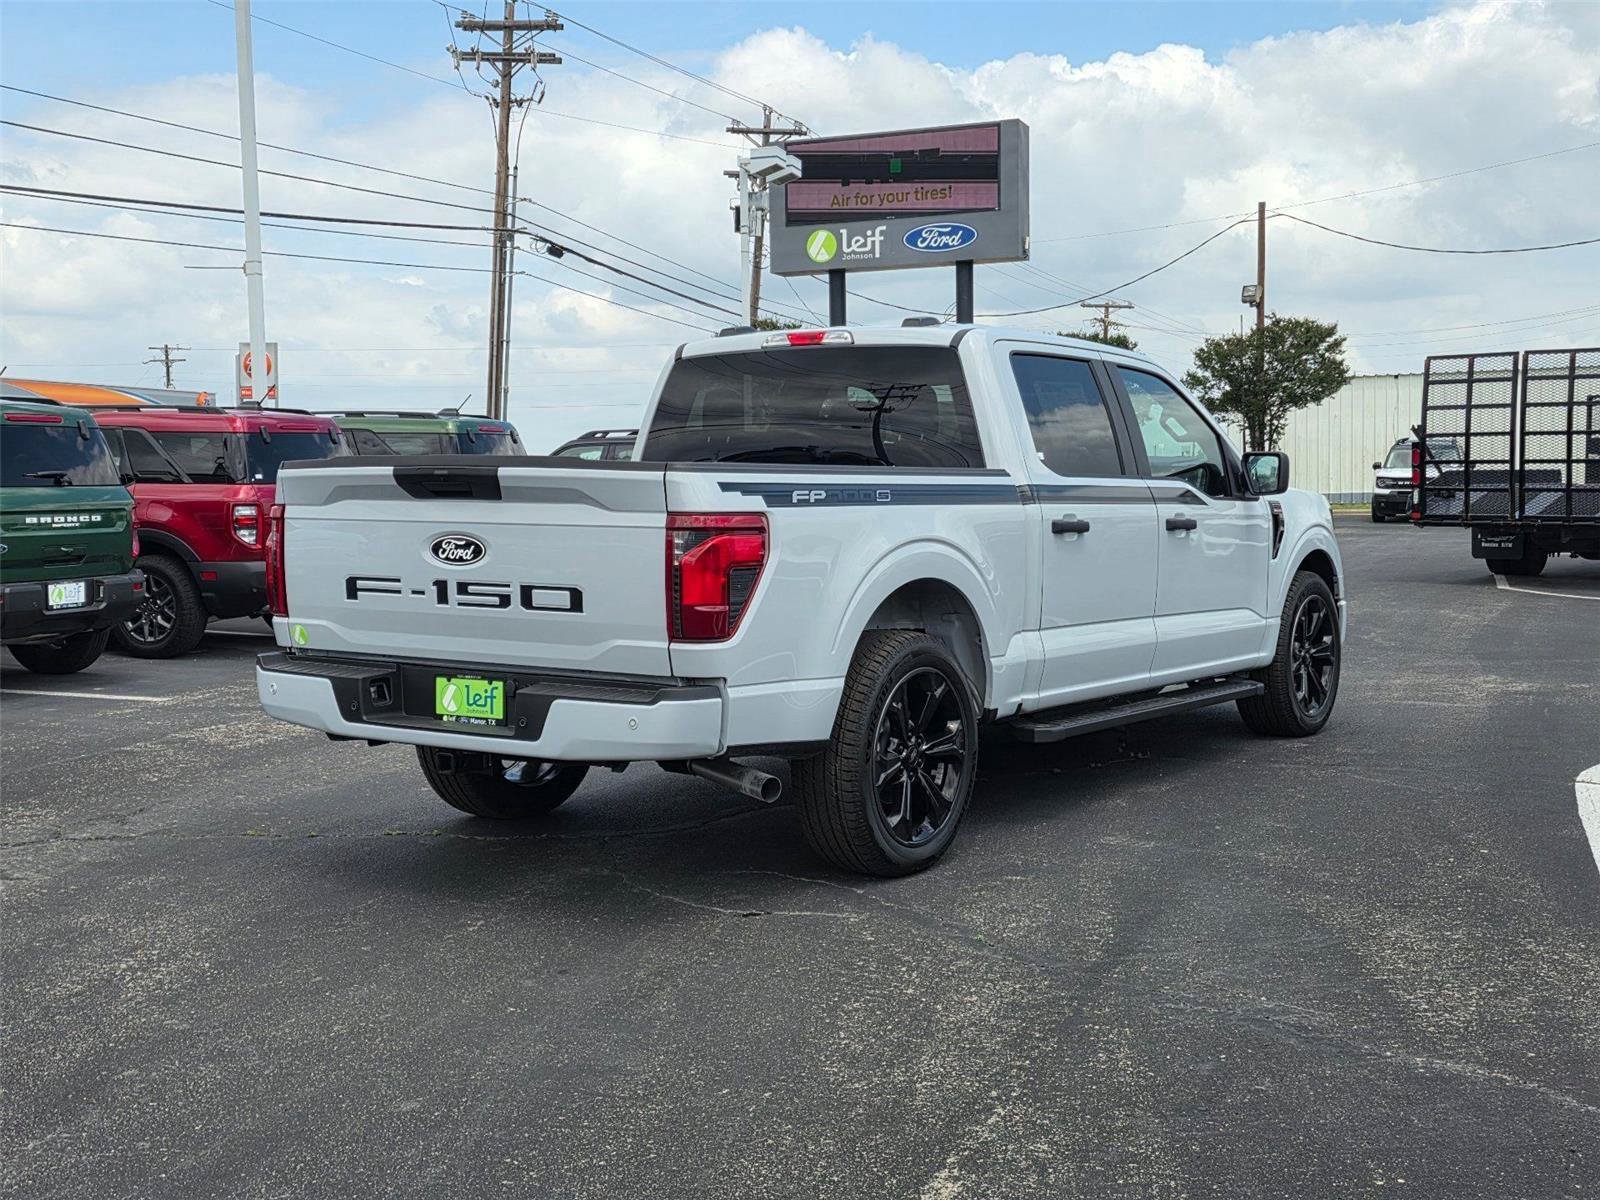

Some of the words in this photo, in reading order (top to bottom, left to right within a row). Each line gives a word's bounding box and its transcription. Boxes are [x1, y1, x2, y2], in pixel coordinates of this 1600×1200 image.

[831, 193, 850, 208] Air
[854, 192, 875, 206] for
[877, 191, 910, 207] your
[914, 185, 952, 201] tires!
[917, 226, 962, 248] Ford
[842, 252, 873, 261] Johnson
[25, 515, 101, 524] BRONCO
[438, 538, 475, 561] Ford
[345, 575, 584, 614] F-150
